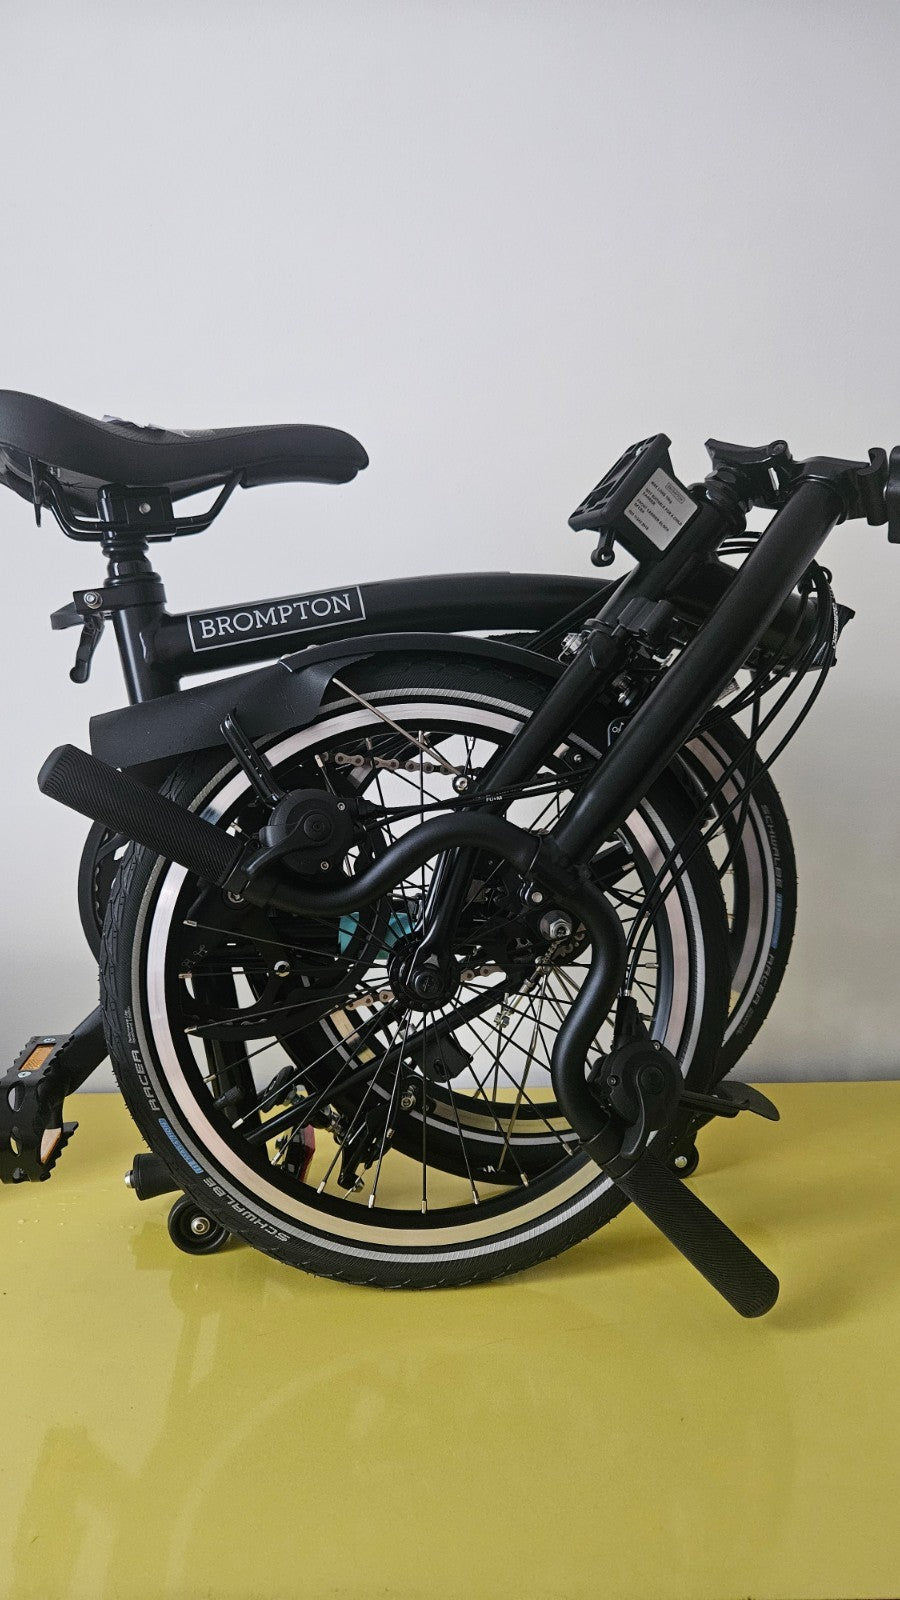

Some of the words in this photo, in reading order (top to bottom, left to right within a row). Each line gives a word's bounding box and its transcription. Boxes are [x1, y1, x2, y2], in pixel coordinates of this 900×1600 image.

[199, 594, 351, 639] BROMPTON
[760, 804, 782, 887] SCHWALBE
[130, 1050, 160, 1110] RACER
[202, 1176, 290, 1242] SCHWALBE
